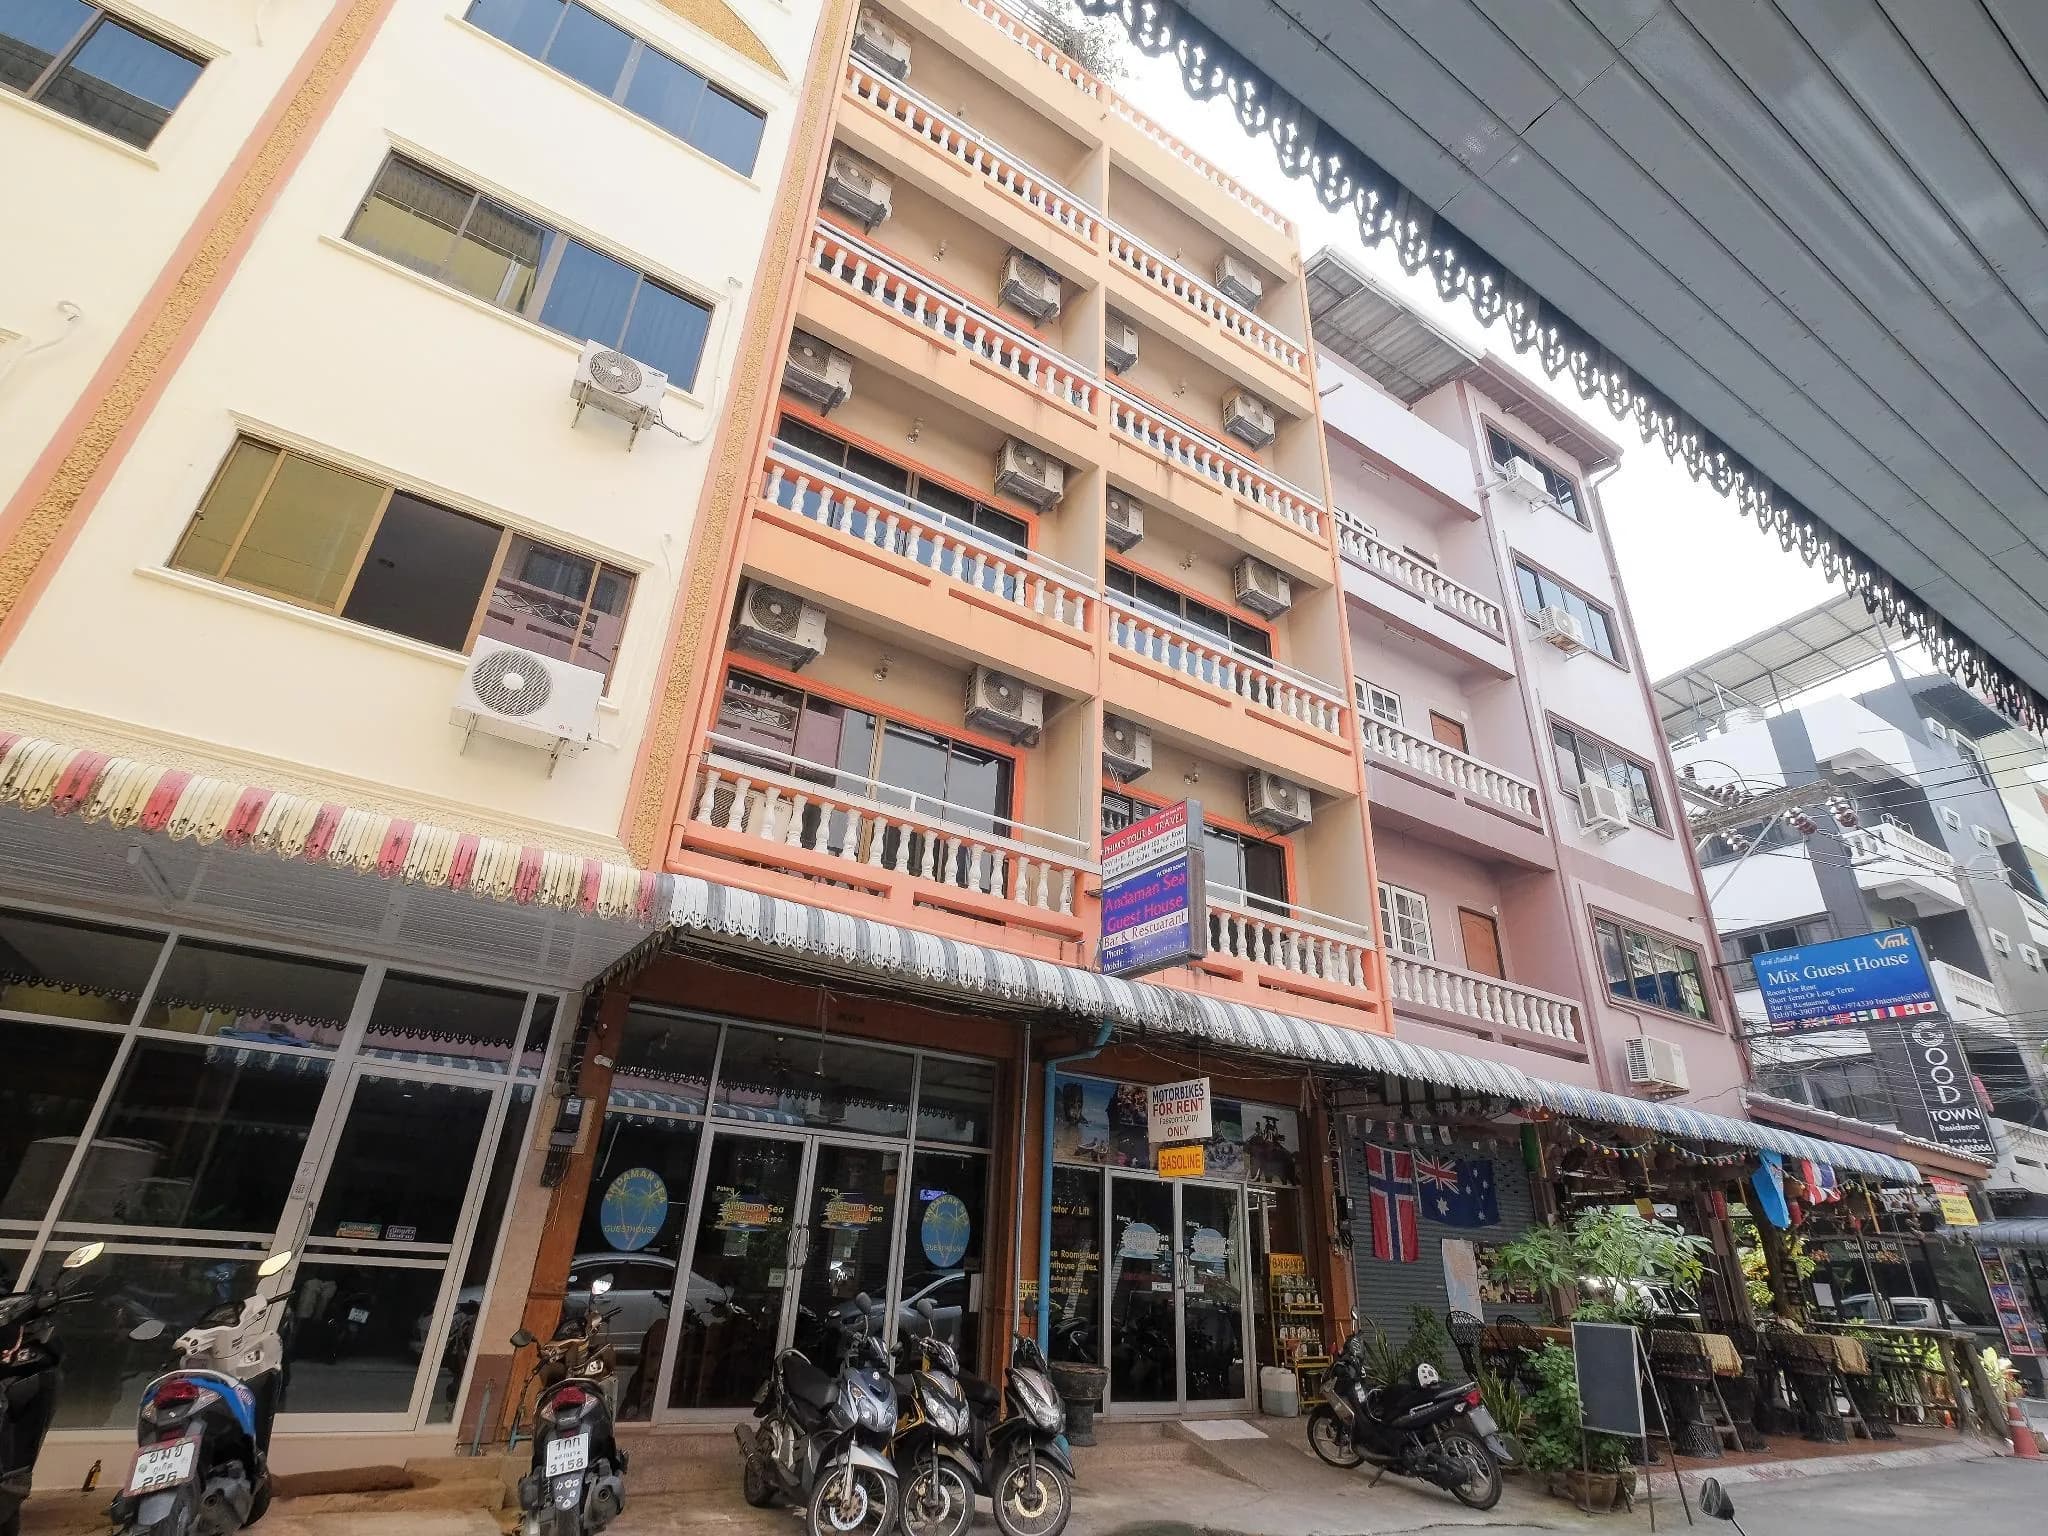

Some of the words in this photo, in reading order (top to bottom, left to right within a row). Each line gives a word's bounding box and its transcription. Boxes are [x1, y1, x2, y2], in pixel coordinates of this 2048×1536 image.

[1155, 812, 1184, 831] TRAVEL
[1104, 883, 1160, 912] Andaman
[1163, 870, 1185, 891] Sea
[1106, 909, 1142, 932] Guest
[1143, 895, 1184, 918] House
[1104, 936, 1119, 949] Bar
[1121, 932, 1128, 942] &
[1768, 969, 1799, 986] Mix
[1803, 962, 1852, 979] Guest
[1855, 951, 1909, 971] House
[1766, 988, 1787, 997] Room
[1788, 985, 1800, 994] For
[1800, 983, 1817, 992] Rent
[1768, 995, 1787, 1005] Short
[1788, 992, 1806, 1002] Term
[1806, 991, 1816, 999] Or
[1816, 988, 1836, 999] Long
[1836, 985, 1855, 995] Term
[1770, 1003, 1784, 1012] Bar
[1911, 1021, 1961, 1104] GOOD
[1152, 1083, 1204, 1103] MOTORBIKES
[1153, 1102, 1174, 1117] FOR
[1176, 1097, 1204, 1115] RENT
[1930, 1107, 1982, 1122] TOWN
[1167, 1126, 1189, 1137] ONLY
[1938, 1123, 1981, 1132] Residence
[1161, 1153, 1201, 1170] GASOLINE
[767, 1204, 785, 1214] Sea
[868, 1204, 884, 1214] Sea
[1078, 1206, 1090, 1216] Lift
[603, 1224, 657, 1234] GUESTHOUSE
[1086, 1251, 1100, 1260] And
[550, 1458, 584, 1474] 3158
